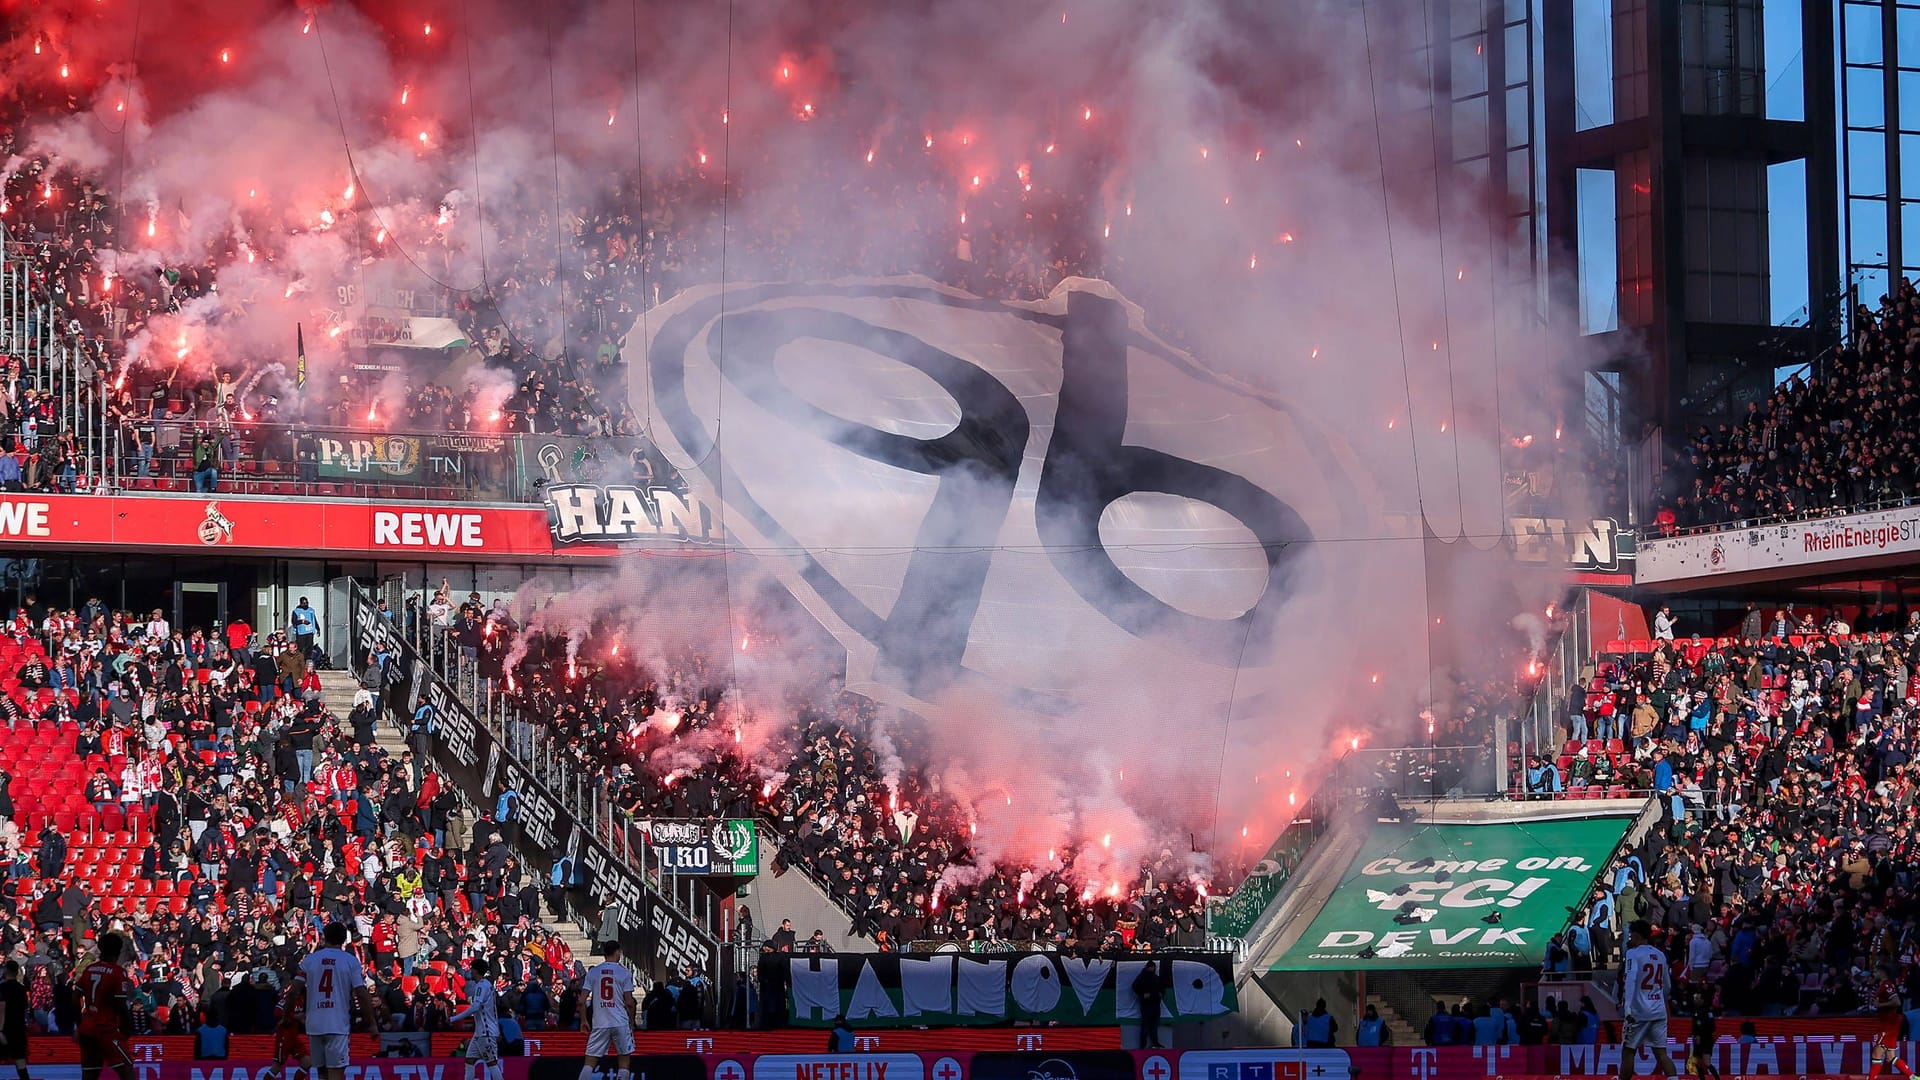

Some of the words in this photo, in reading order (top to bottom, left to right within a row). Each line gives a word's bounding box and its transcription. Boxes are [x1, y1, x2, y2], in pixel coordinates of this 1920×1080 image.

[550, 487, 724, 540] HAN
[706, 290, 1318, 690] 96
[374, 511, 483, 547] REWE
[356, 602, 403, 666] SILBER
[430, 682, 477, 748] SILBER
[432, 713, 468, 767] PFEIL
[507, 764, 556, 830] SILBER
[584, 845, 640, 911] SILBER
[1361, 857, 1509, 876] Come
[1515, 856, 1592, 872] on,
[590, 877, 630, 931] PFIL
[1376, 877, 1550, 911] FC!
[651, 904, 709, 972] SILBER
[1318, 927, 1535, 948] DEVK
[318, 969, 333, 999] 4
[600, 976, 614, 1000] 6
[1641, 963, 1664, 991] 24
